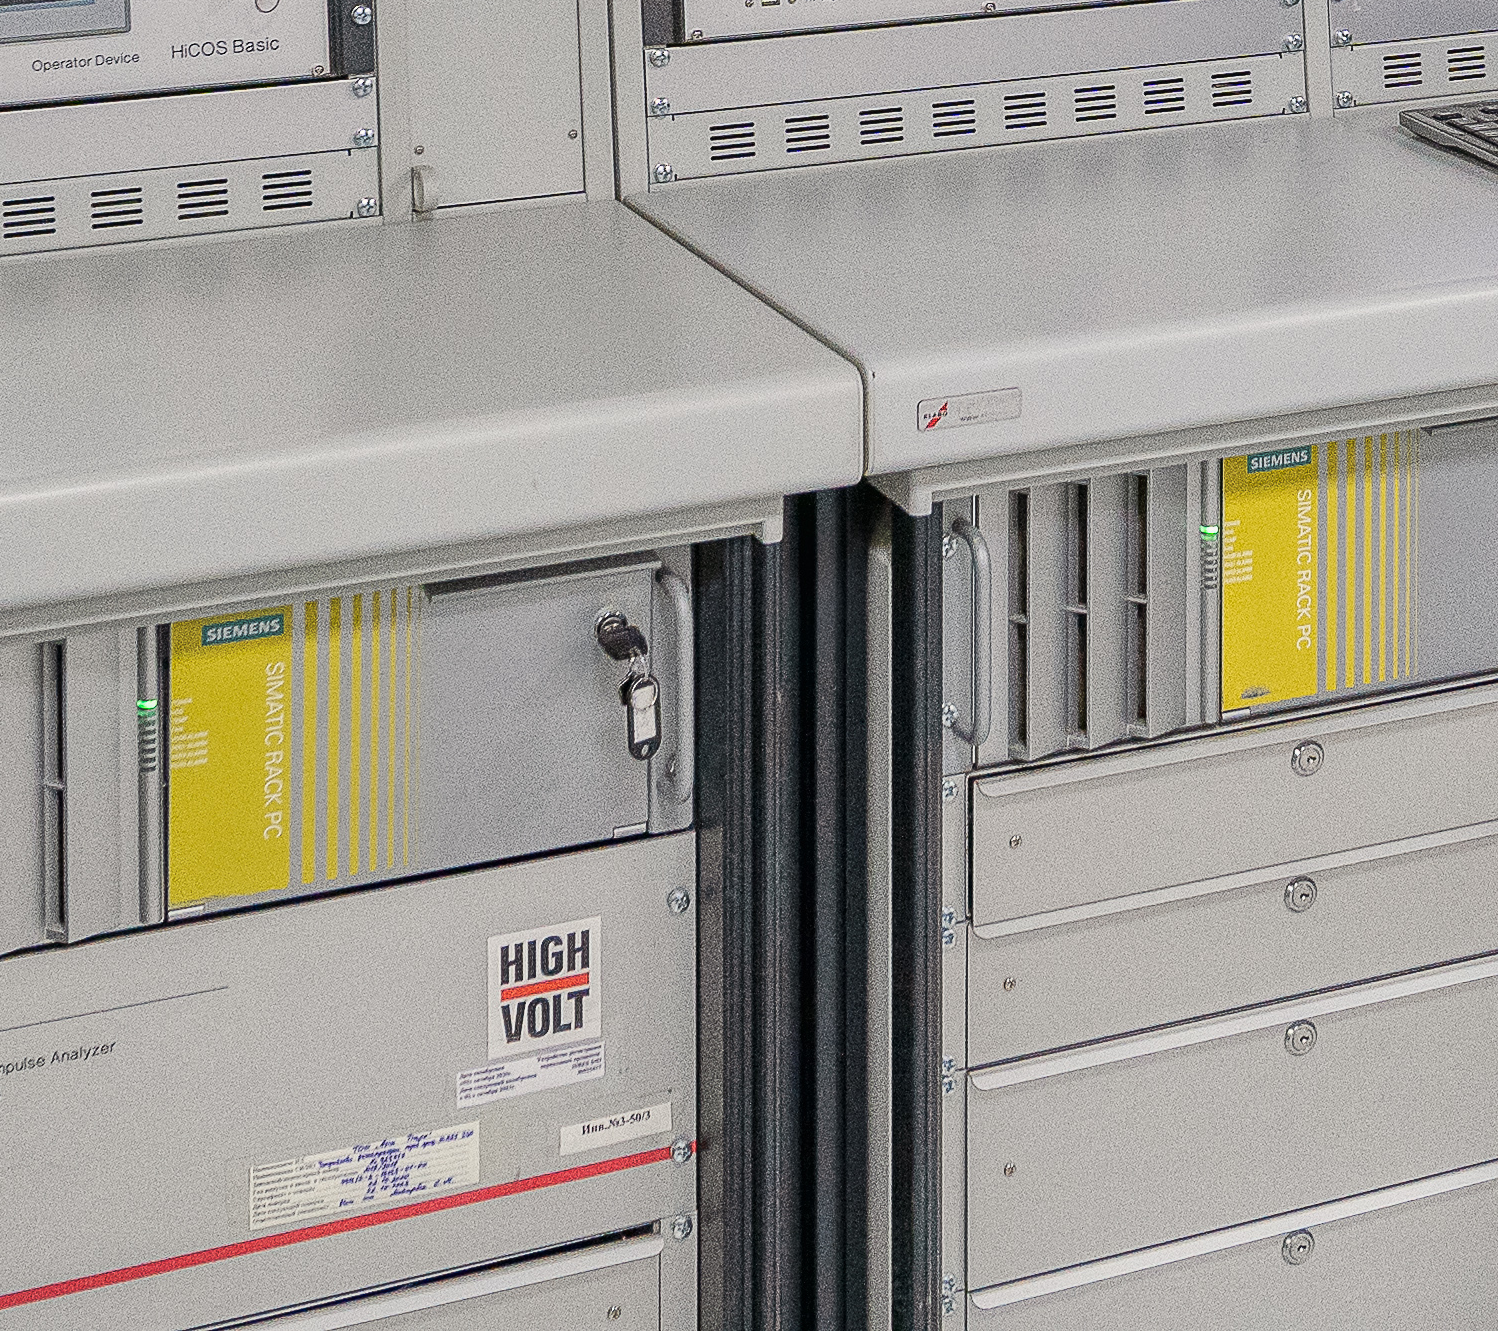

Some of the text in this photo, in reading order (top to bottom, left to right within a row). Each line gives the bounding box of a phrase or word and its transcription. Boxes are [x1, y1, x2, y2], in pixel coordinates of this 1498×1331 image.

[172, 37, 280, 59] HiCOS Basic
[32, 52, 140, 73] Operator Device
[1251, 450, 1308, 470] SIEMENS
[1296, 489, 1311, 650] SIMATIC RACK PC
[206, 618, 280, 642] SIEMENS
[264, 661, 285, 840] SIMATIC RACK PC
[499, 931, 590, 986] HIGH
[501, 989, 590, 1044] VOLT
[50, 1039, 117, 1067] Analyzer
[582, 1111, 651, 1135] Инв.№3-50/3
